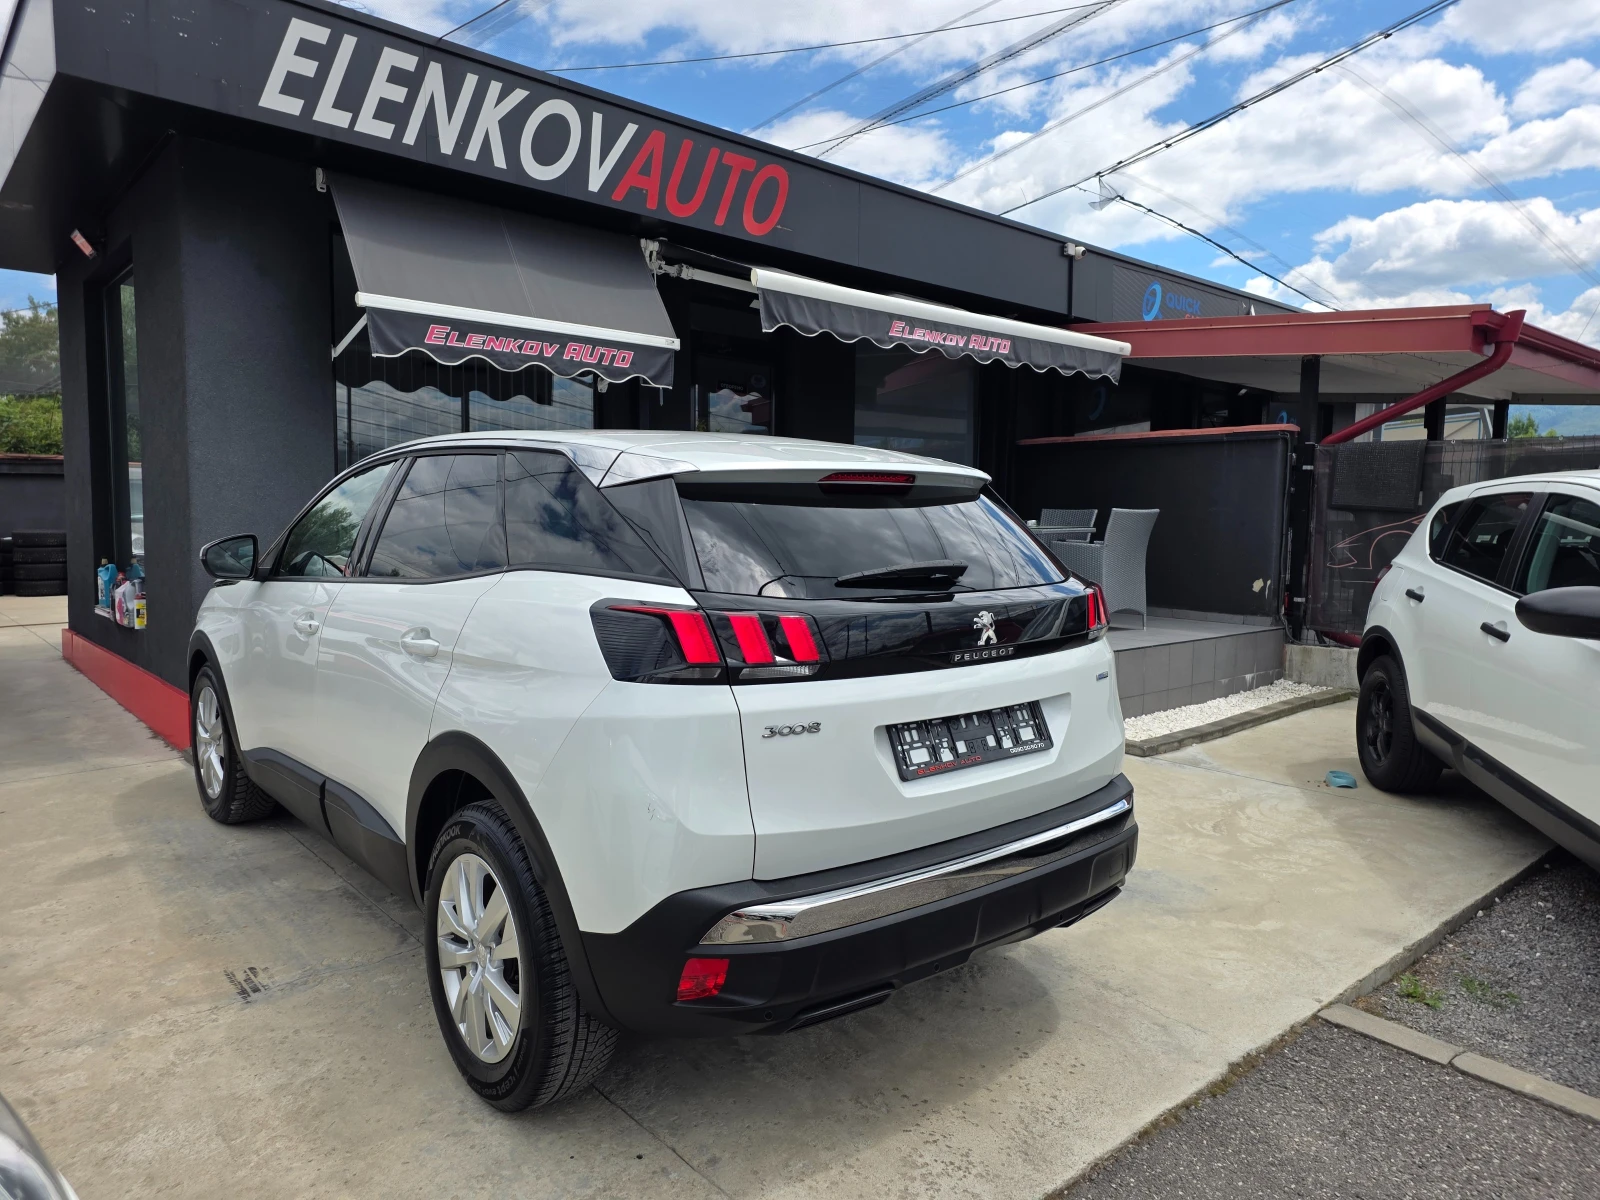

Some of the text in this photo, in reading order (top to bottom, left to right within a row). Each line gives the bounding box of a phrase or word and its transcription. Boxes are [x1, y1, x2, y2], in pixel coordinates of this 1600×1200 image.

[1165, 292, 1201, 314] QUICK
[424, 324, 635, 368] ELENKOV AUTO
[889, 320, 1012, 354] ELENKOV AUTO
[954, 647, 1015, 662] PEUGEOT
[761, 721, 822, 739] 3008
[960, 755, 982, 766] AUTO
